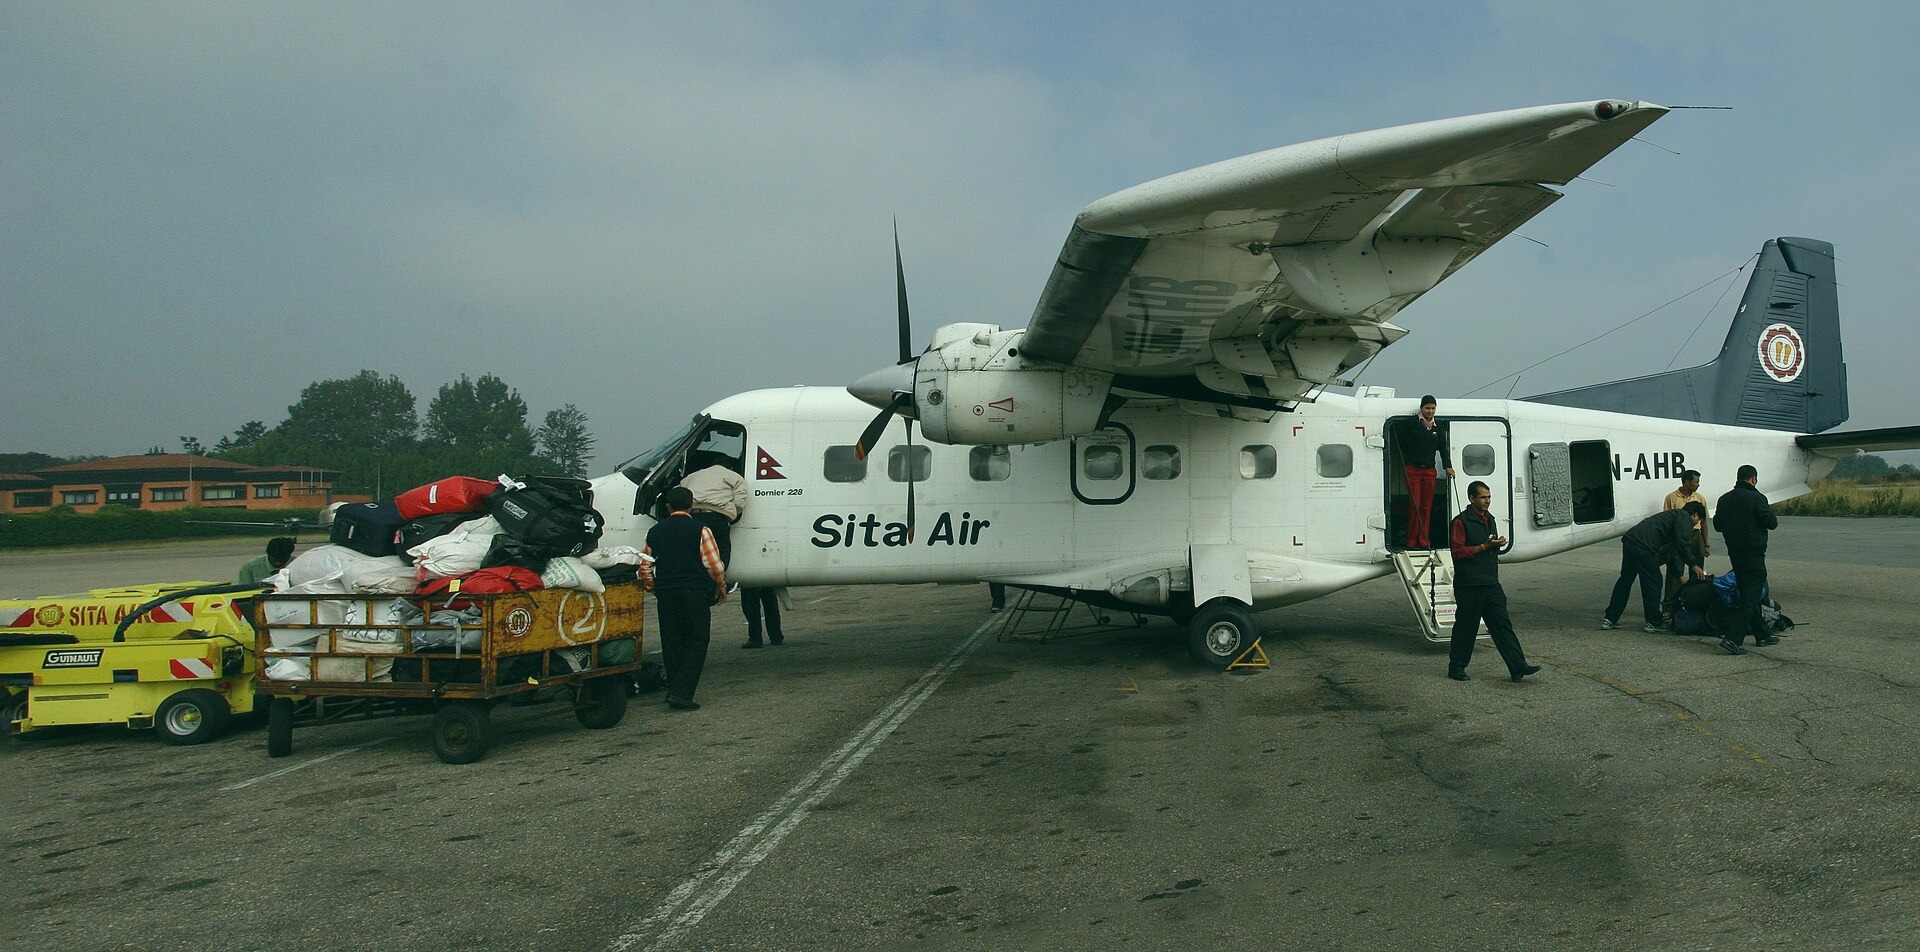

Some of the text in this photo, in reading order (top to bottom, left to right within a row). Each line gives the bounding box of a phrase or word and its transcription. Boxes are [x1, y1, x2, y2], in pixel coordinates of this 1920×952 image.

[754, 488, 804, 497] Dornier 228
[811, 511, 991, 548] Sita Air
[69, 606, 109, 626] SITA
[572, 592, 597, 634] 2
[47, 653, 100, 664] GUINAULT
